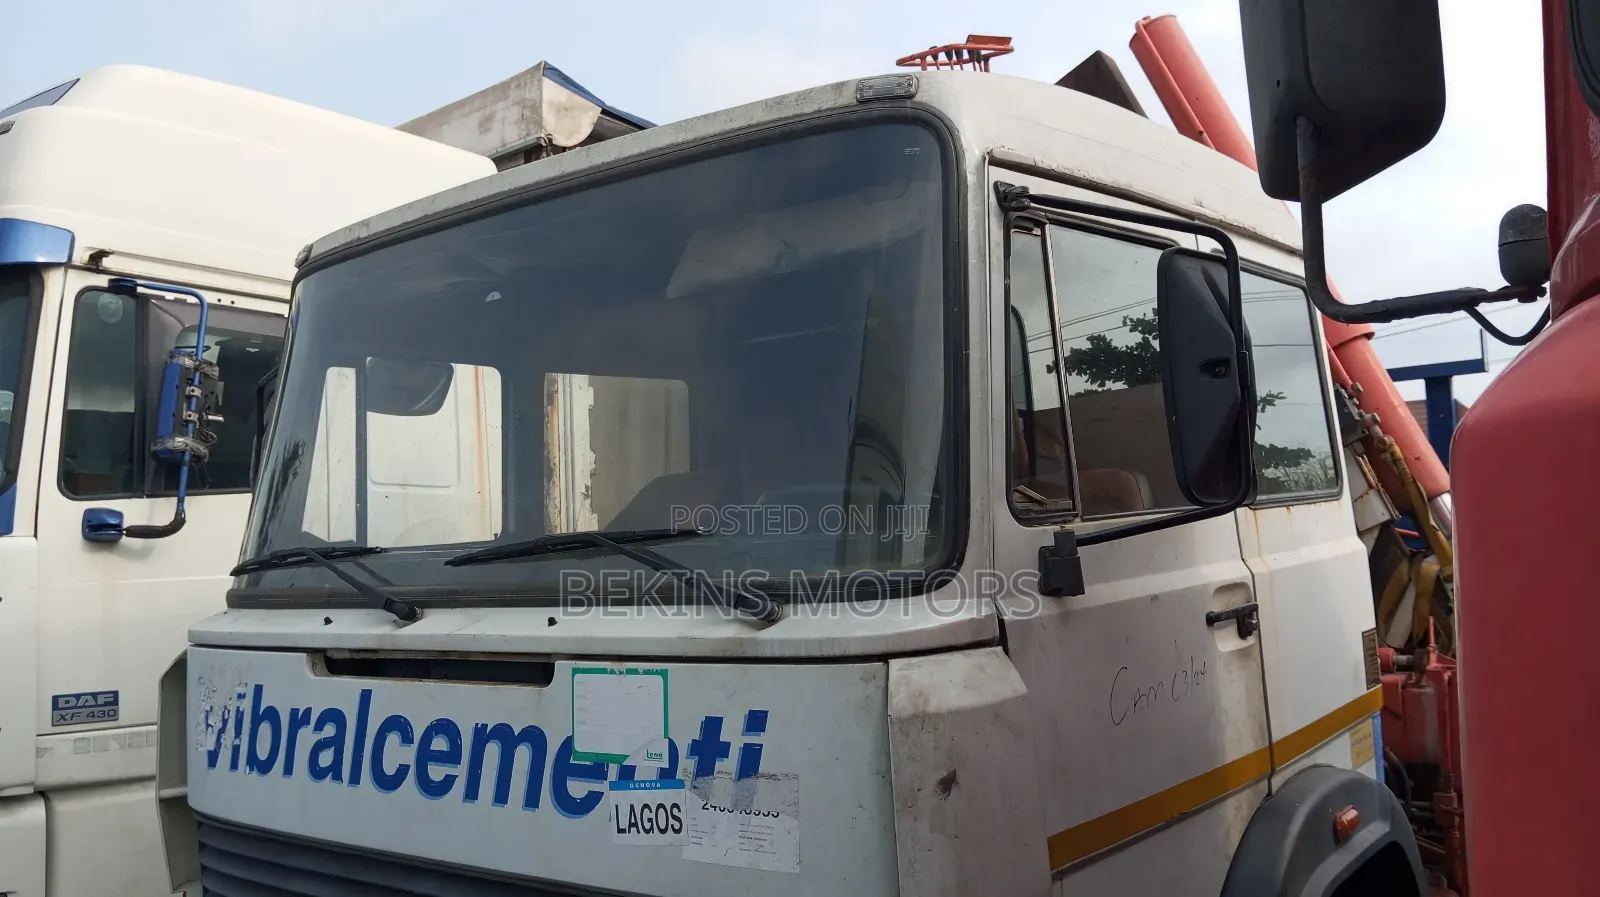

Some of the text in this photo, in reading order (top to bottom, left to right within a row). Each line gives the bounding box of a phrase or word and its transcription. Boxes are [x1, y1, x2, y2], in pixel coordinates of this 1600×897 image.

[58, 694, 114, 708] DAF
[56, 709, 117, 722] XF 430
[615, 802, 683, 835] LAGOS
